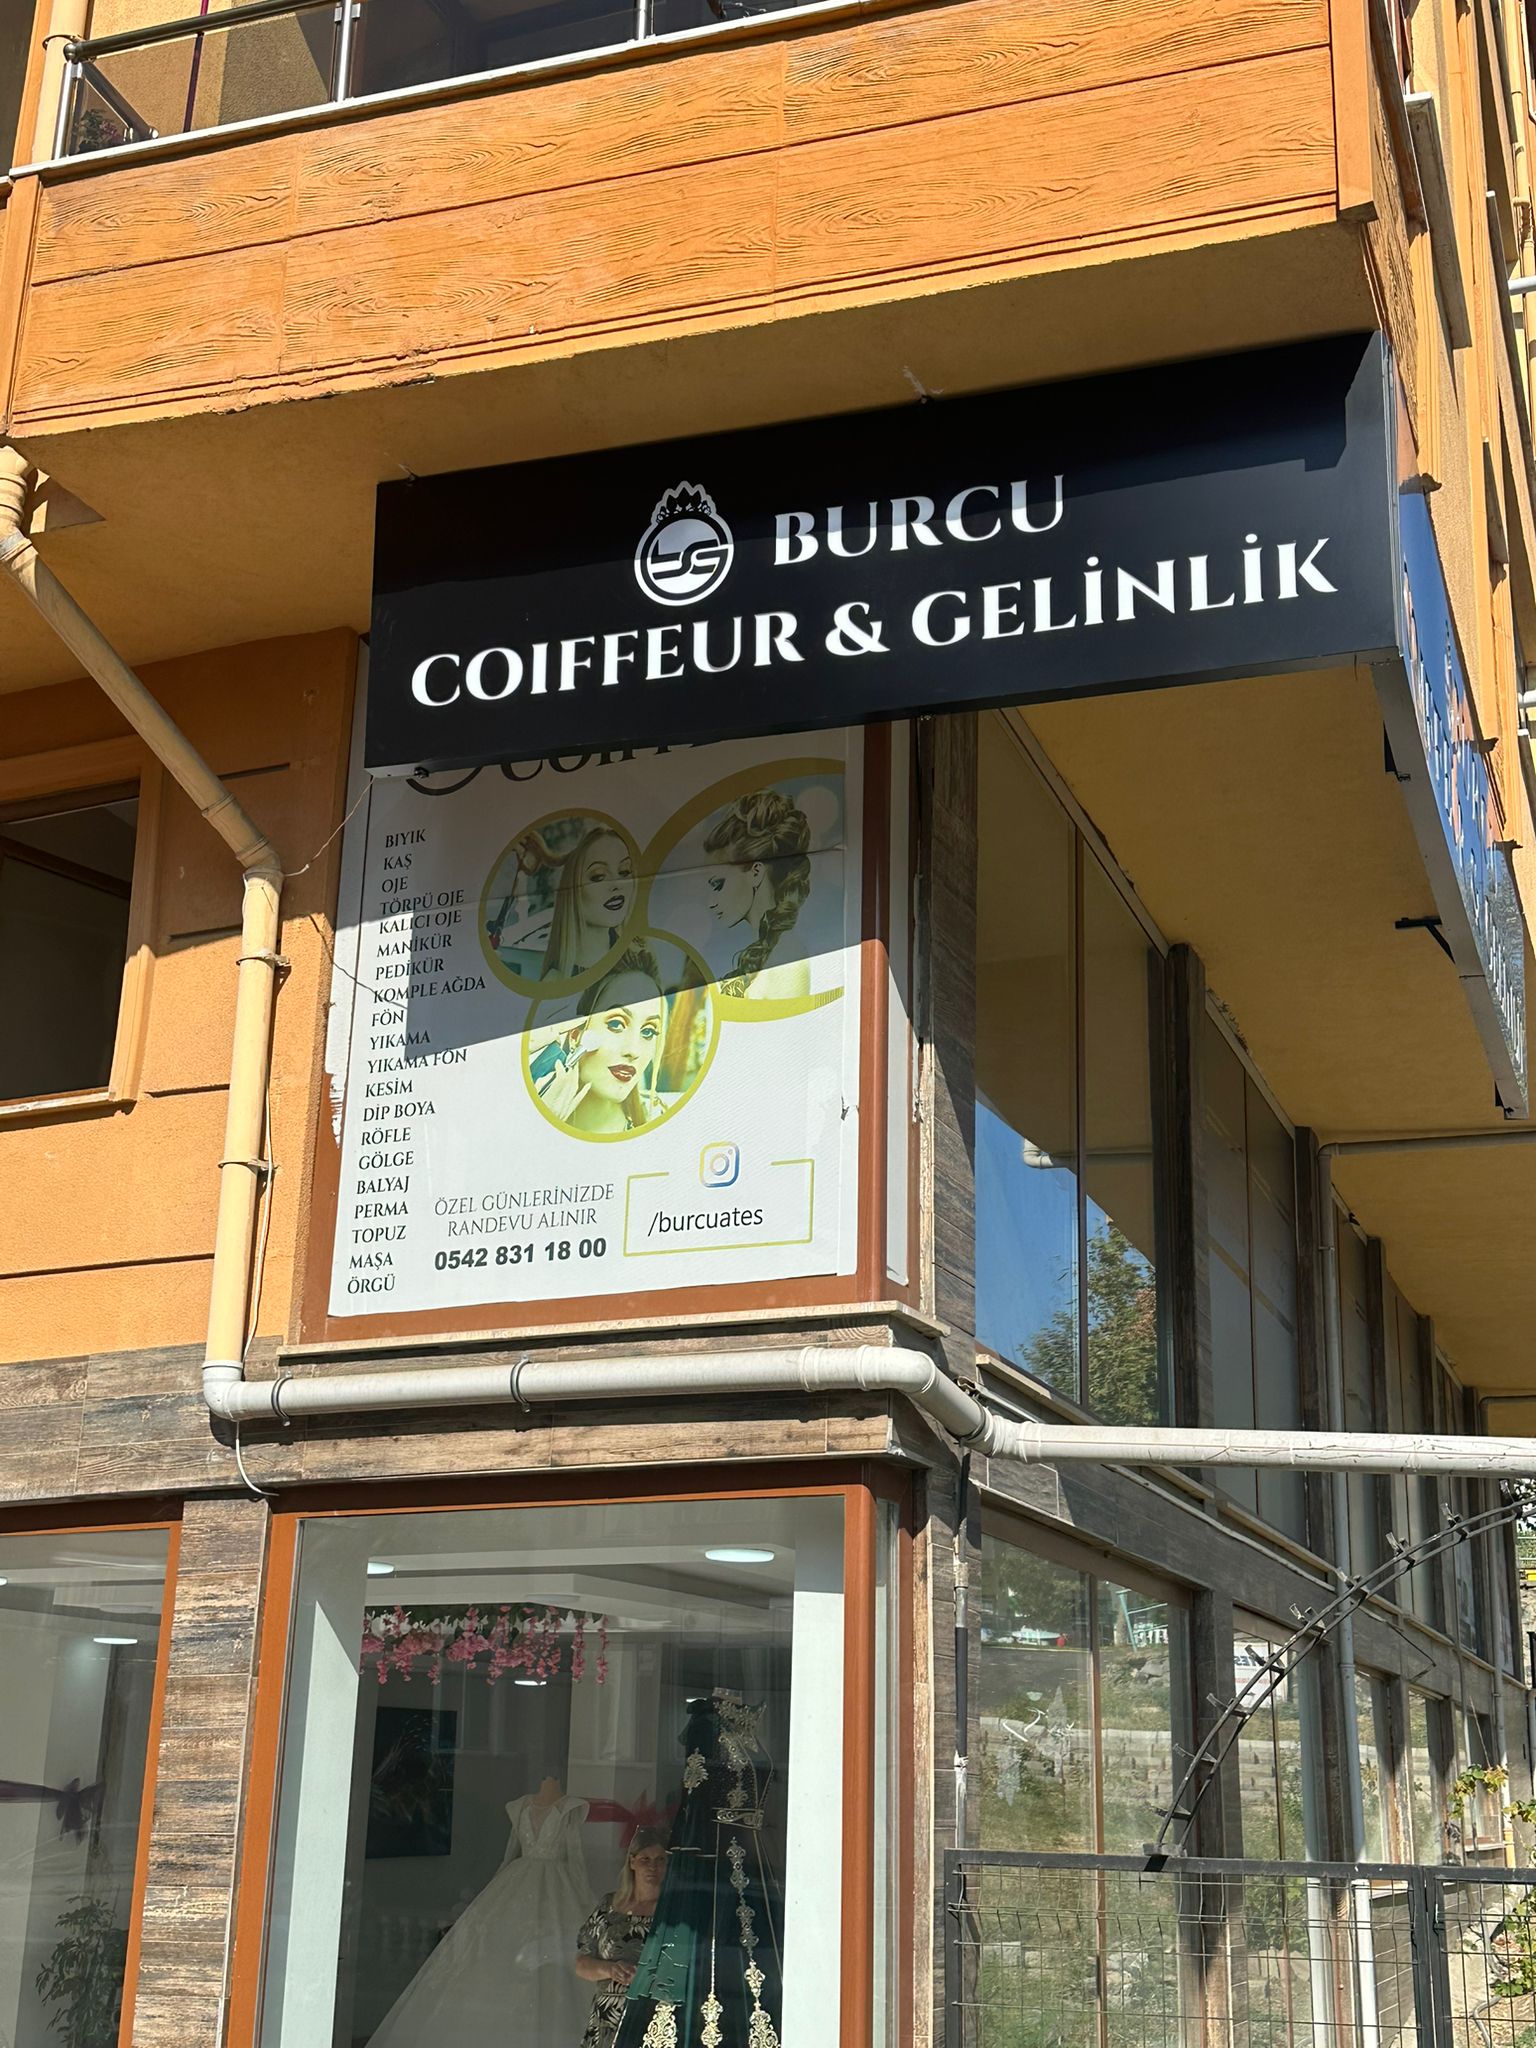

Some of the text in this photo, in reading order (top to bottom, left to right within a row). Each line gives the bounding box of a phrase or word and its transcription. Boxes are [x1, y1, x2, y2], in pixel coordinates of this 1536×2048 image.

[773, 474, 1064, 567] BURCU
[411, 533, 1339, 707] COIFFEUR & GELİNLİK
[385, 829, 427, 848] BIYIK
[383, 854, 412, 871] KAŞ
[381, 876, 408, 894] OJE
[380, 890, 465, 915] TÖRPÜ OJE
[379, 910, 462, 934] KALICI OJE
[377, 934, 452, 958] MANİKÜR
[375, 958, 445, 980] PEDİKÜR
[374, 975, 486, 1004] KOMPLE AĞDA
[371, 1009, 405, 1027] FÖN
[369, 1030, 431, 1051] YIKAMA
[367, 1048, 467, 1074] YIKAMA FÖN
[365, 1079, 413, 1098] KESİM
[363, 1101, 436, 1122] DİP BOYA
[361, 1127, 412, 1146] RÖFLE
[358, 1151, 414, 1170] GÖLGE
[356, 1176, 410, 1196] BALYAJ
[354, 1201, 409, 1219] PERMA
[434, 1184, 615, 1216] ÖZEL GÜNLERİNİZDE
[448, 1208, 598, 1238] RANDEVU ALINIR
[648, 1206, 763, 1237] /burcuates
[352, 1225, 407, 1244] TOPUZ
[349, 1252, 393, 1270] MAŞA
[434, 1237, 607, 1271] 0542 831 18 00
[347, 1274, 396, 1295] ÖRGÜ
